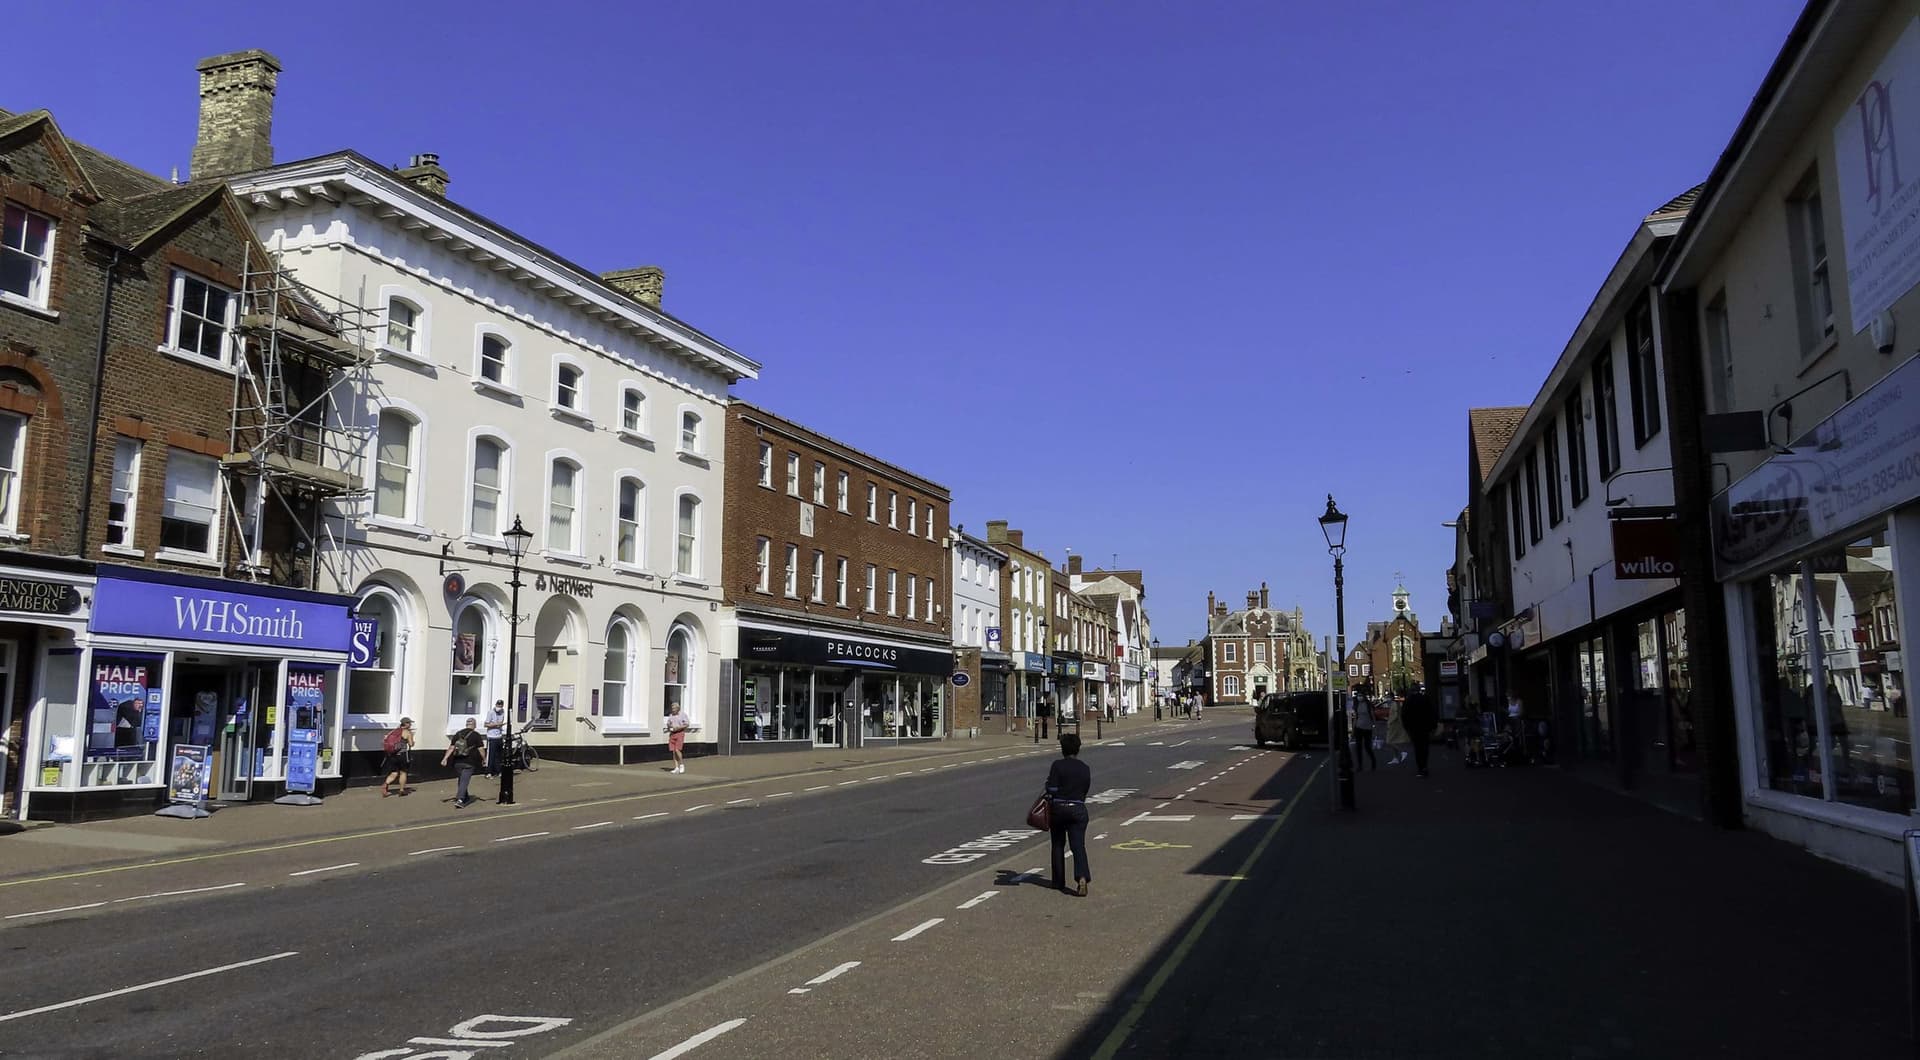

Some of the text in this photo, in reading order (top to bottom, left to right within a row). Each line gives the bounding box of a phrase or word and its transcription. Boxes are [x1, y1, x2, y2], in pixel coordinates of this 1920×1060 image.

[1621, 556, 1674, 573] wilko
[0, 579, 68, 600] ENSTONE
[549, 575, 593, 599] NatWest
[0, 593, 59, 611] AMBERS
[173, 596, 303, 639] WHSmith
[355, 622, 372, 632] WH
[350, 632, 370, 664] S
[827, 642, 896, 661] PEACOCKS
[96, 664, 146, 682] HALF
[288, 671, 323, 688] HALF
[100, 681, 141, 695] PRICE
[291, 686, 320, 698] PRICE
